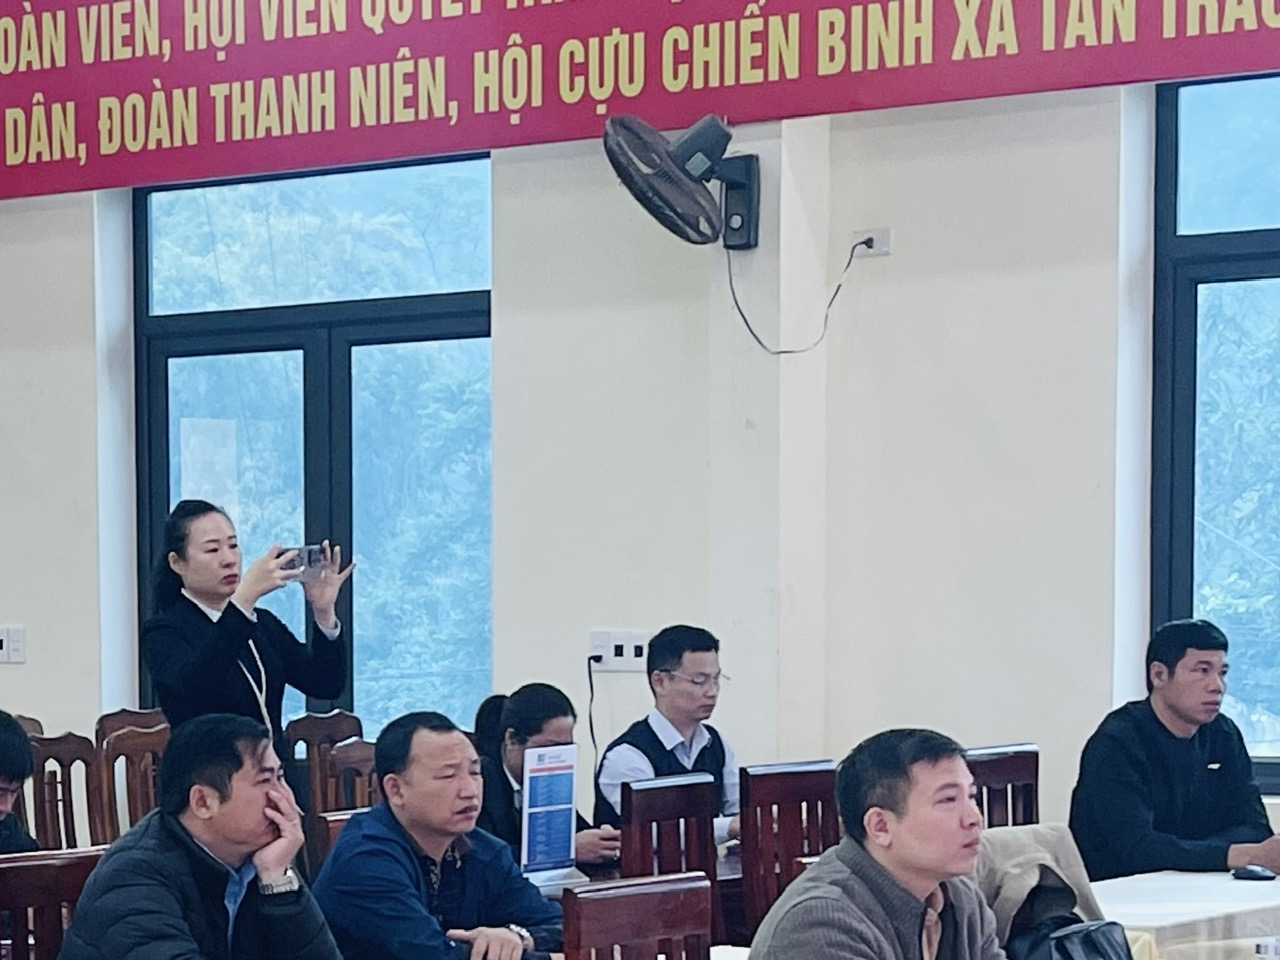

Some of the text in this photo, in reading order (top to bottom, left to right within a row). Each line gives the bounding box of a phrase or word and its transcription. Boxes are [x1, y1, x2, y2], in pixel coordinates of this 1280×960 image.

[5, 91, 86, 166] DÂN,
[97, 78, 197, 153] ĐOÀN
[210, 70, 335, 140] THANH
[350, 47, 458, 125] NIÊN,
[474, 33, 543, 122] HỘI
[558, 27, 645, 114] CỰU
[661, 0, 800, 92] CHIẾN
[817, 0, 933, 75] BINH
